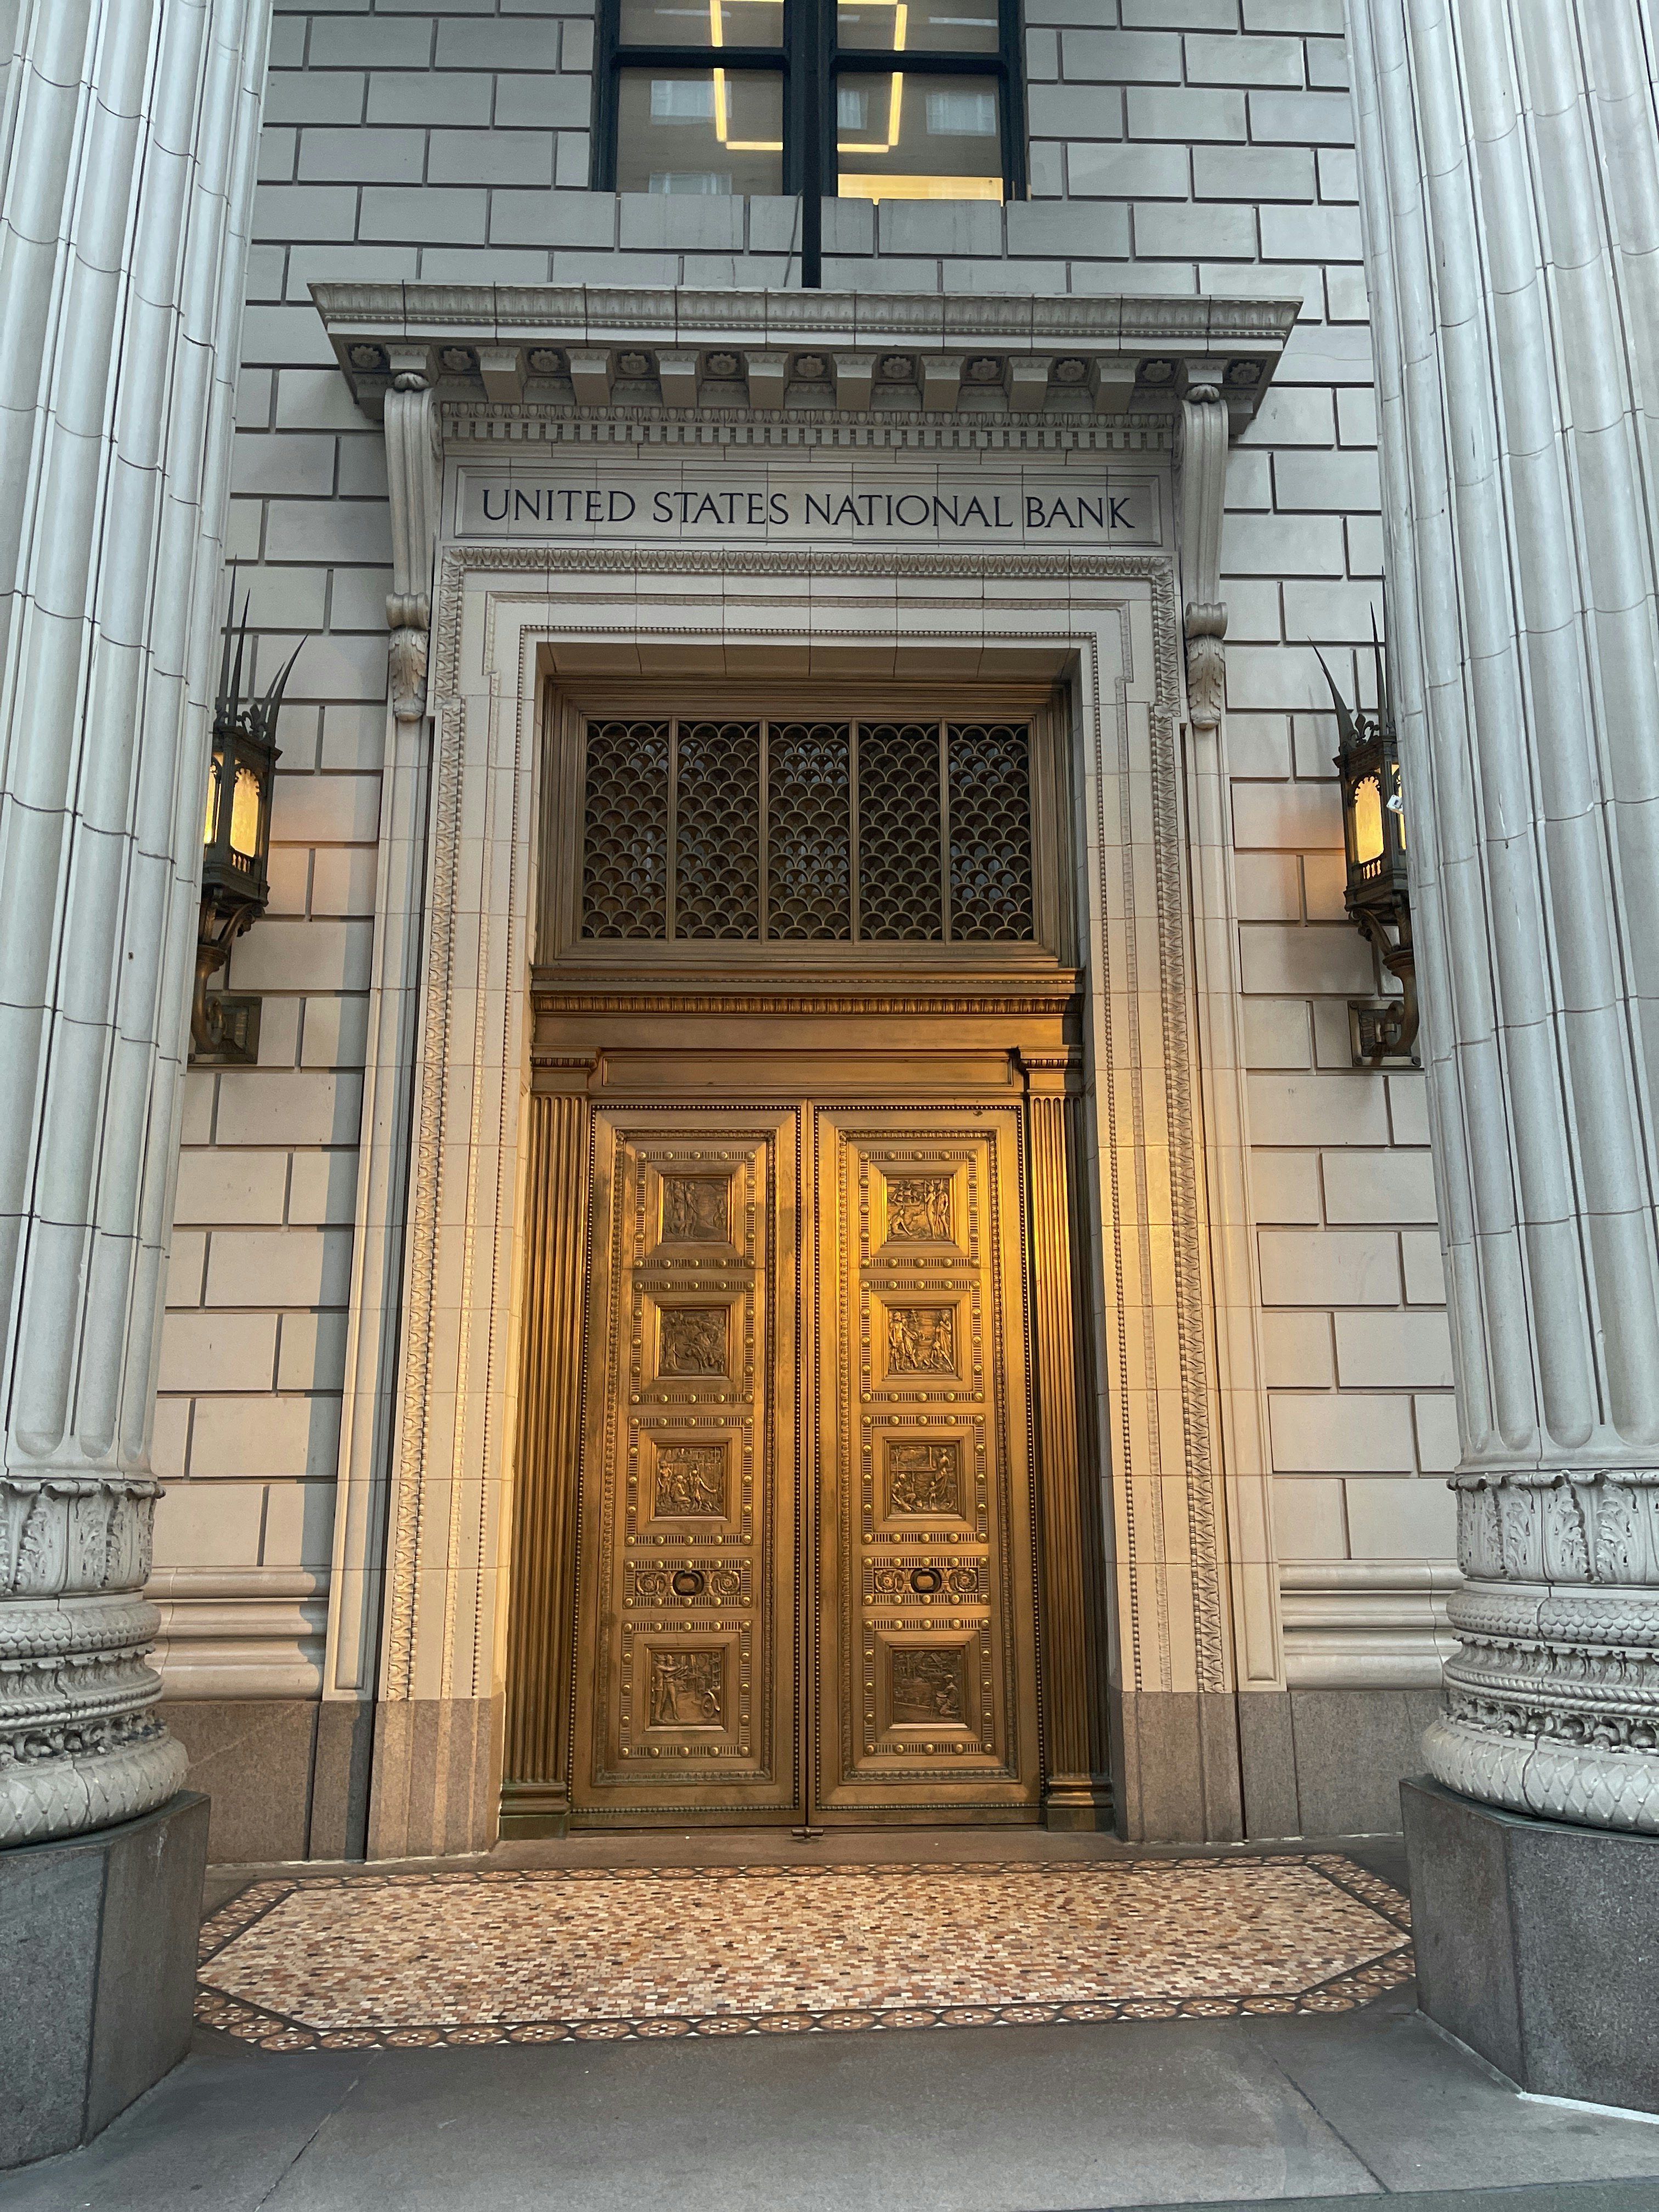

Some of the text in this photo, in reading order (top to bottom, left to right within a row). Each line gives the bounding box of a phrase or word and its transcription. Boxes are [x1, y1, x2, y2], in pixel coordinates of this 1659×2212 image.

[482, 489, 1135, 528] UNITED STATES NATIONAL BANK
